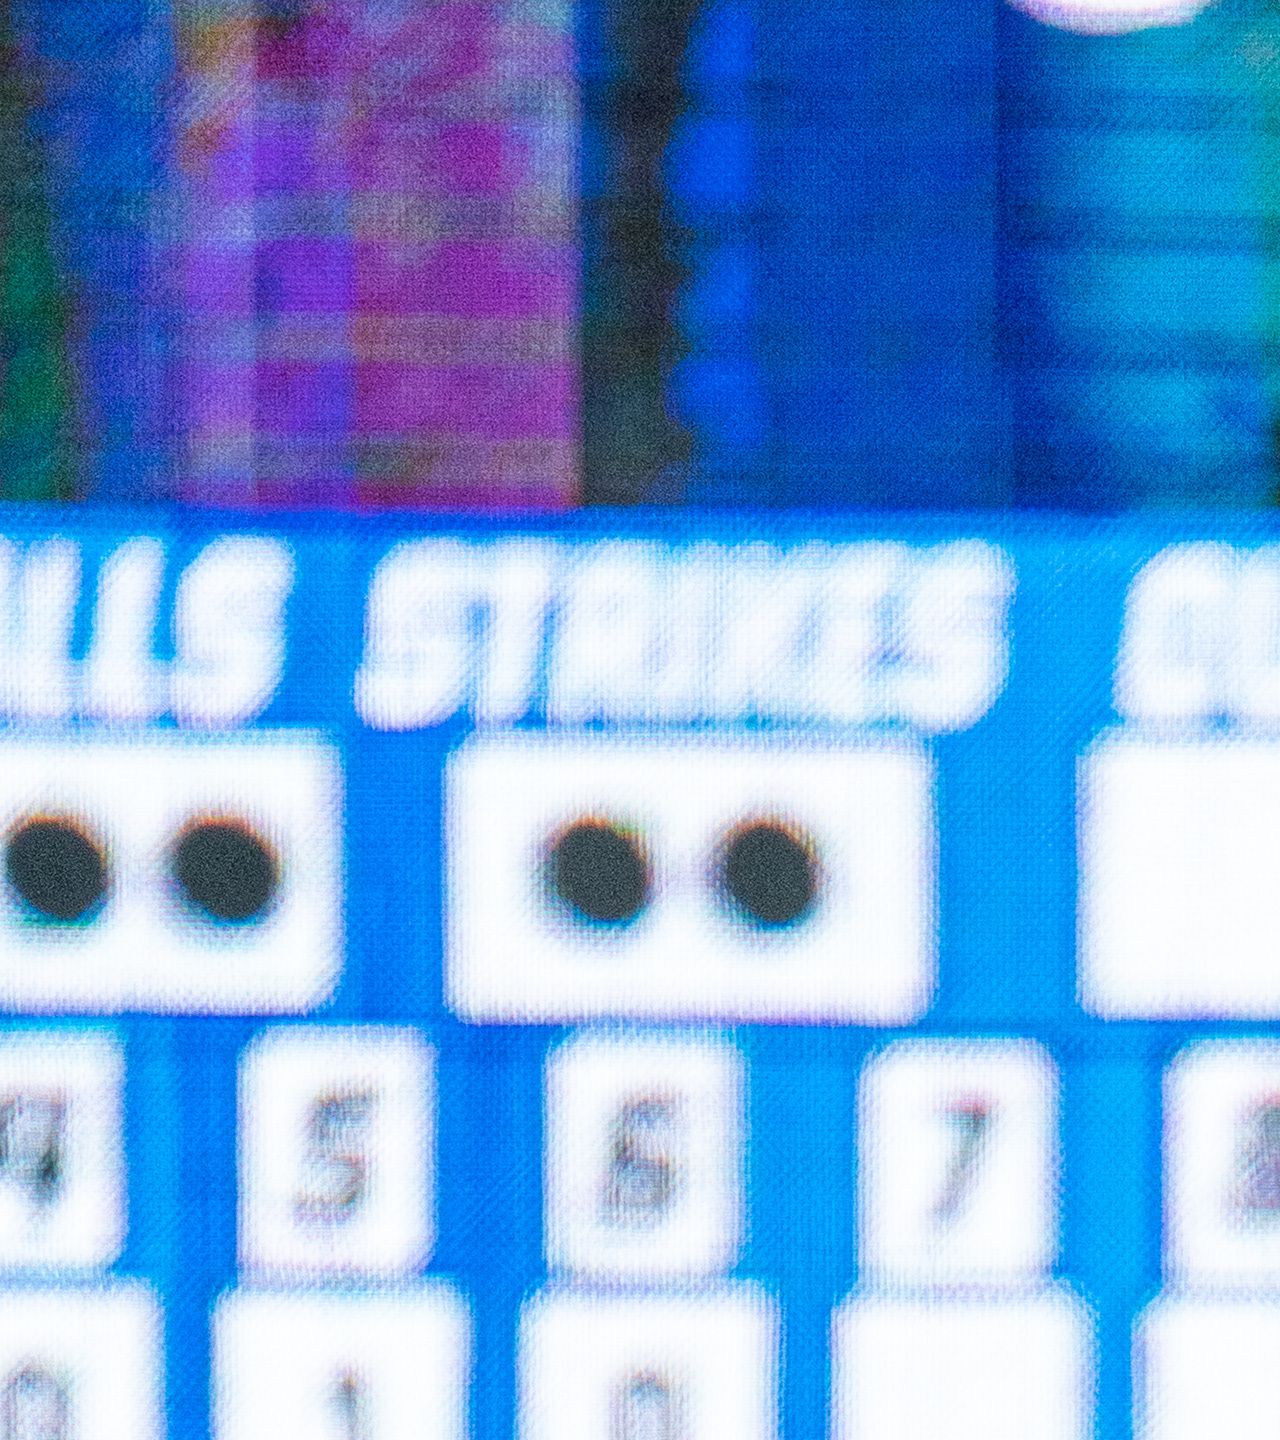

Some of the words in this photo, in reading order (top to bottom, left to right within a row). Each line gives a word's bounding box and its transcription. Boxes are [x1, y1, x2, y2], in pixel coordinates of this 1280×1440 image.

[355, 538, 1013, 734] STRIKES
[294, 1084, 380, 1226] 5
[602, 1086, 688, 1224] 6
[930, 1086, 998, 1223] 7
